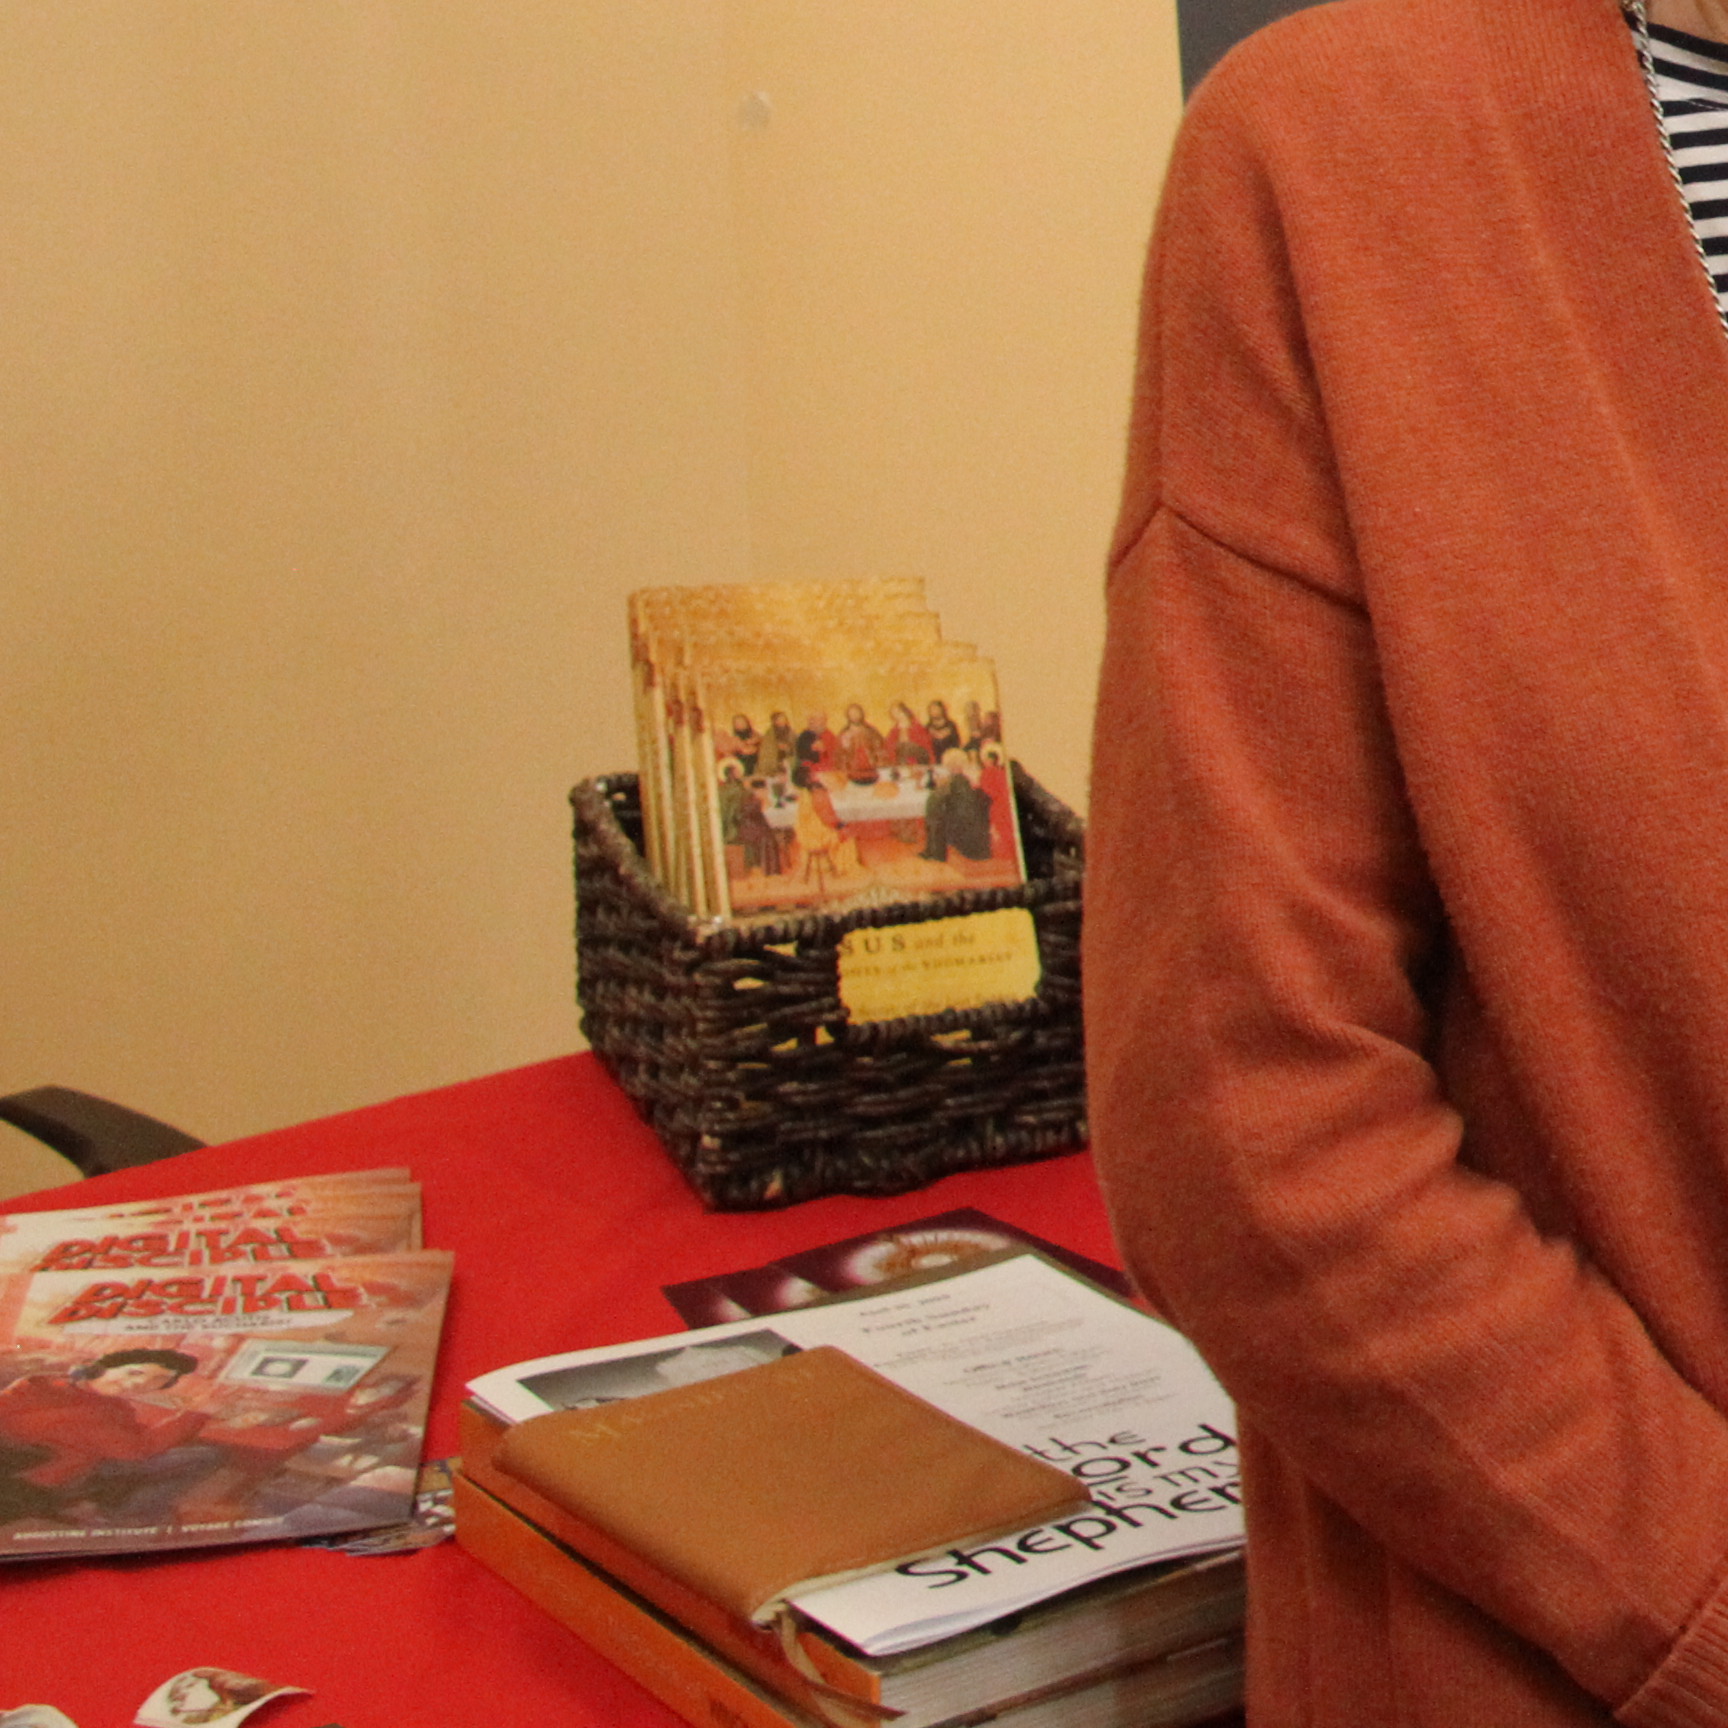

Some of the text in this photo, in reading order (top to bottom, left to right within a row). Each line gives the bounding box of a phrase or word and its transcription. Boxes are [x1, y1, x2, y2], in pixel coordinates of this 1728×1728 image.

[78, 1271, 340, 1306] DIGITAL
[48, 1288, 366, 1325] DISCIPLE
[1021, 1429, 1147, 1462] the
[1071, 1423, 1238, 1486] ord
[1096, 1480, 1154, 1502] is
